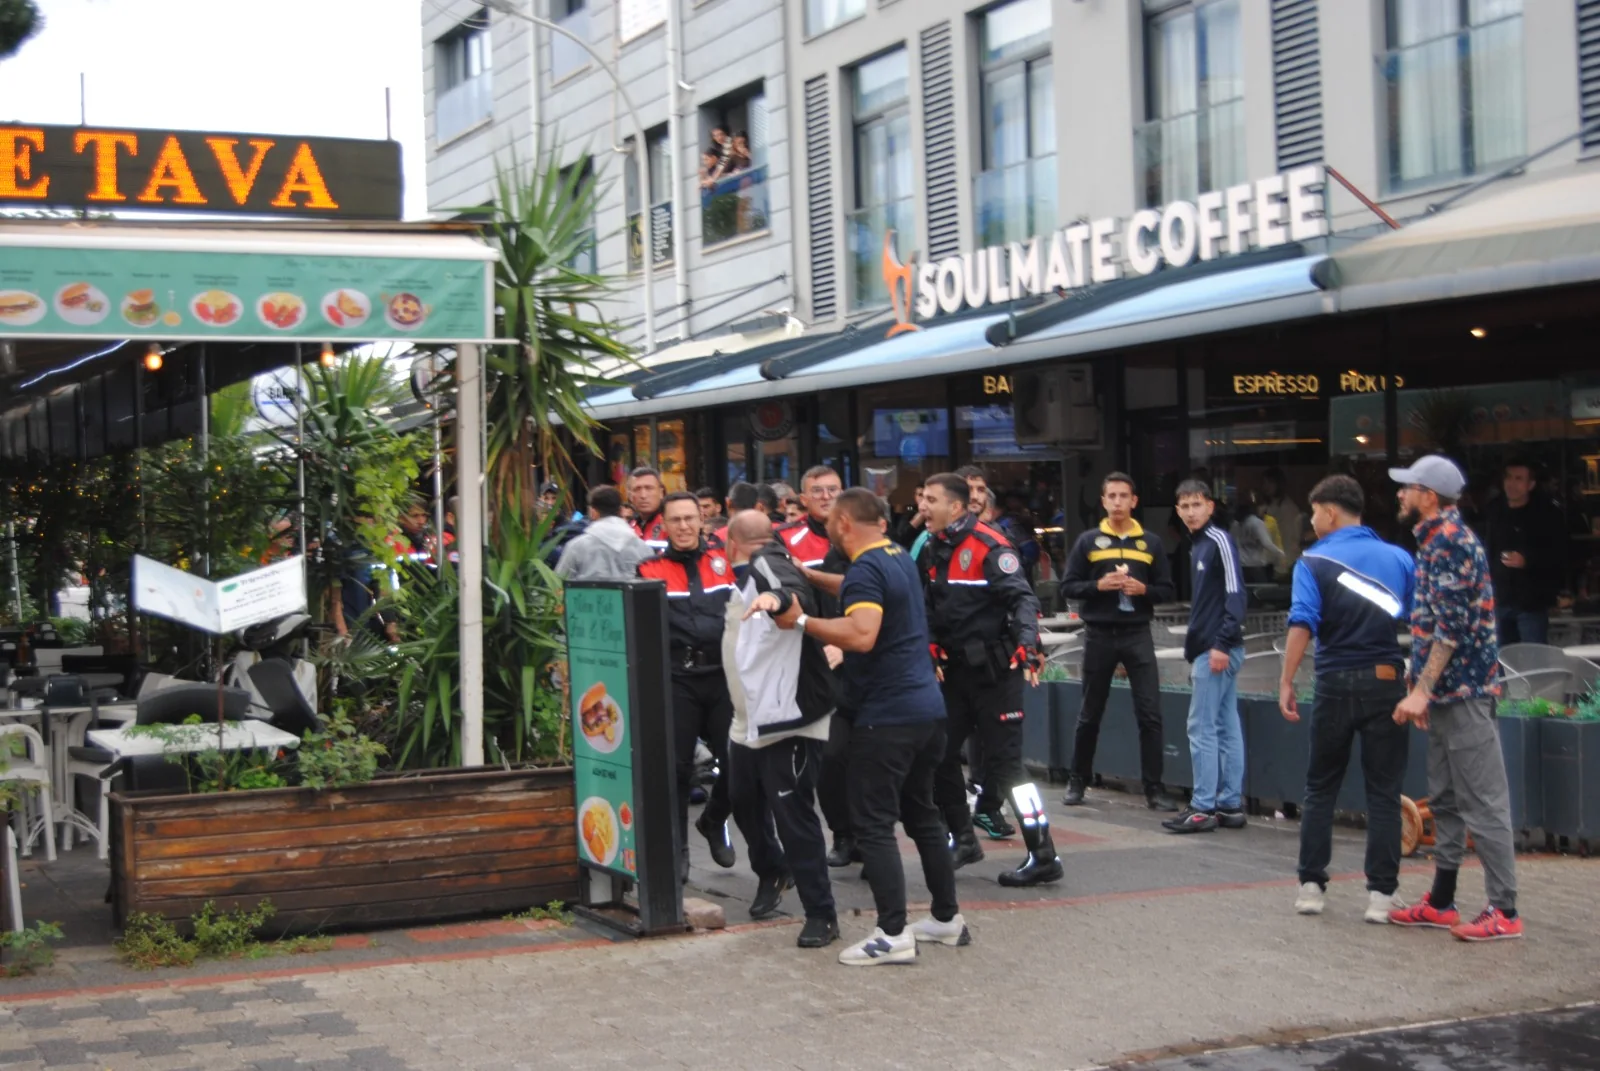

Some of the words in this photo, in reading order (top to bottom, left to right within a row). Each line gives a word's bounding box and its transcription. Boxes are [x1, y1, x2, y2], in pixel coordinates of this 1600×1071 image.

[0, 128, 50, 199] E
[74, 130, 339, 209] TAVA
[917, 217, 1120, 319] SOULMATE
[1127, 164, 1329, 276] COFFEE
[983, 375, 1013, 395] BA
[1233, 374, 1319, 394] ESPRESSO
[1340, 372, 1378, 393] PICK
